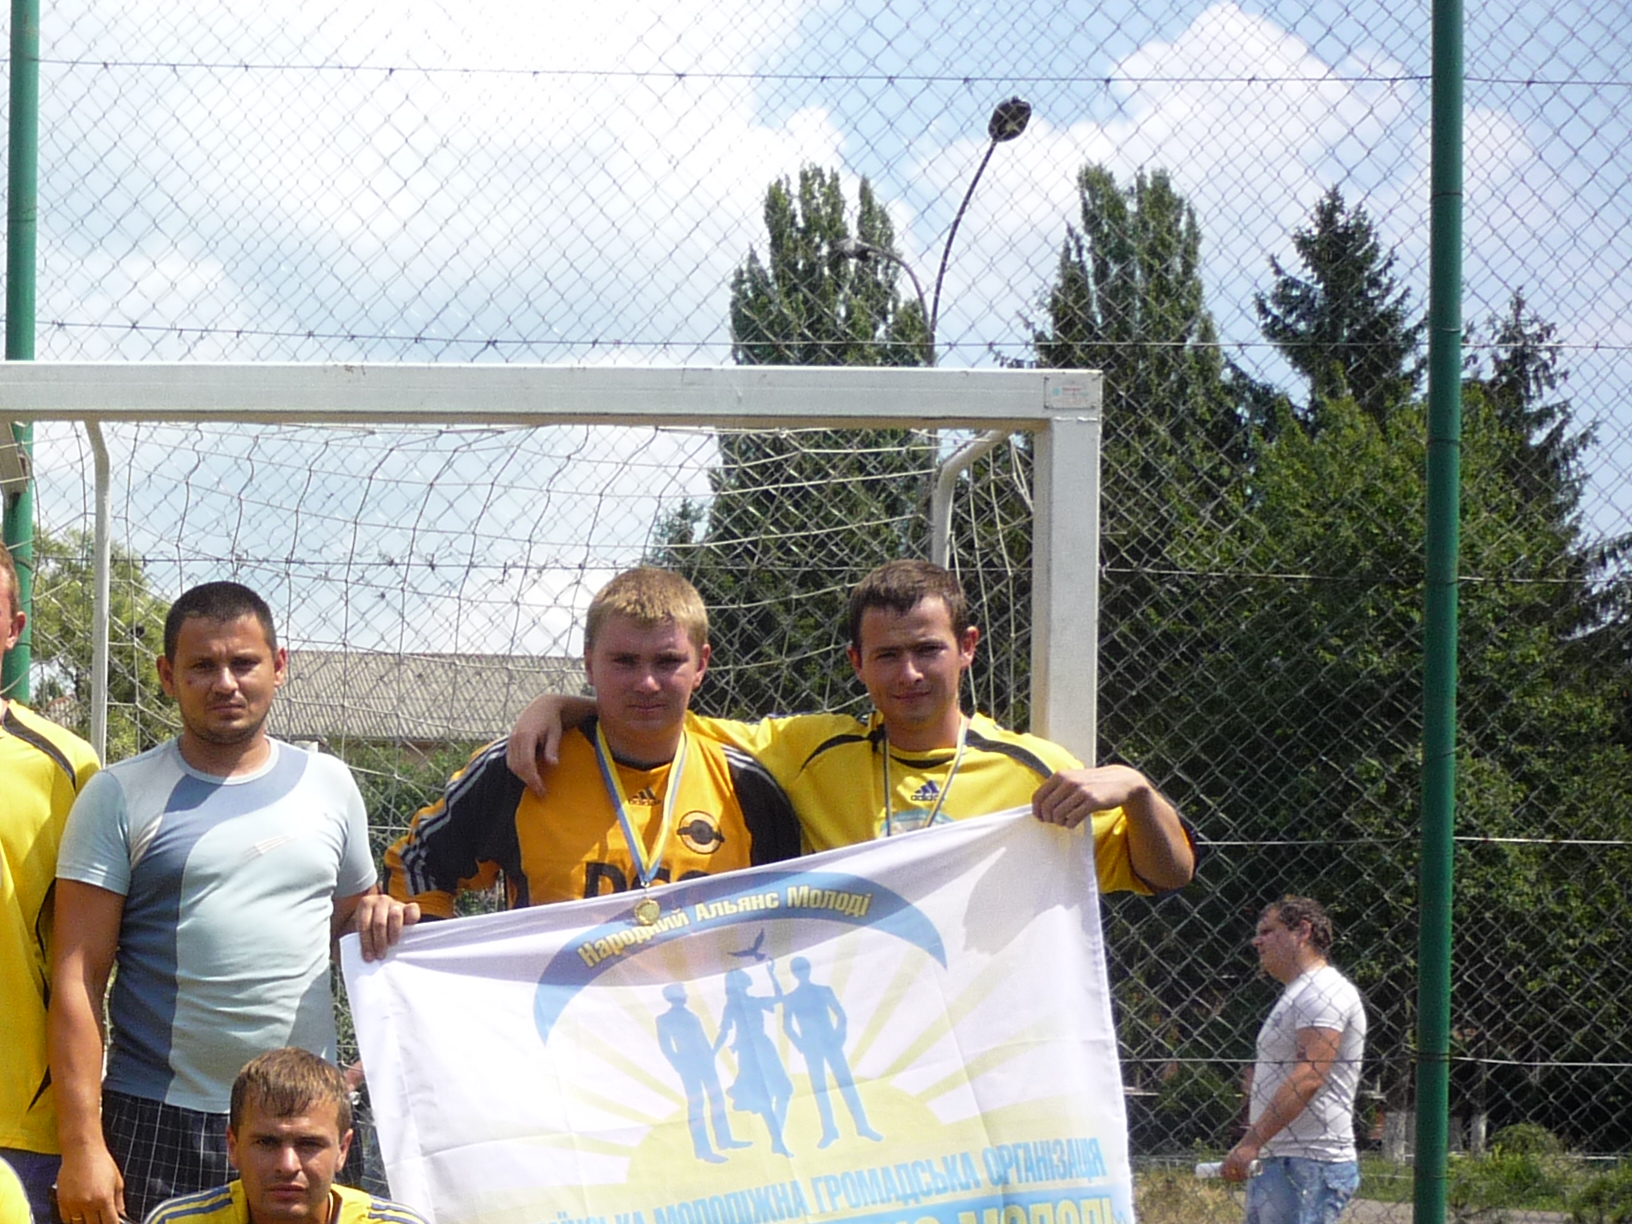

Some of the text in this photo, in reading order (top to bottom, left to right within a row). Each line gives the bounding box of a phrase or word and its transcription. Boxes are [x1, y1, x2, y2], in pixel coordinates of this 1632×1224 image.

[577, 885, 872, 968] Народний Альянс Молоді
[810, 1151, 982, 1215] ГРОМАДСЬКА
[981, 1137, 1108, 1188] ОРГАНІЗАЦІЯ
